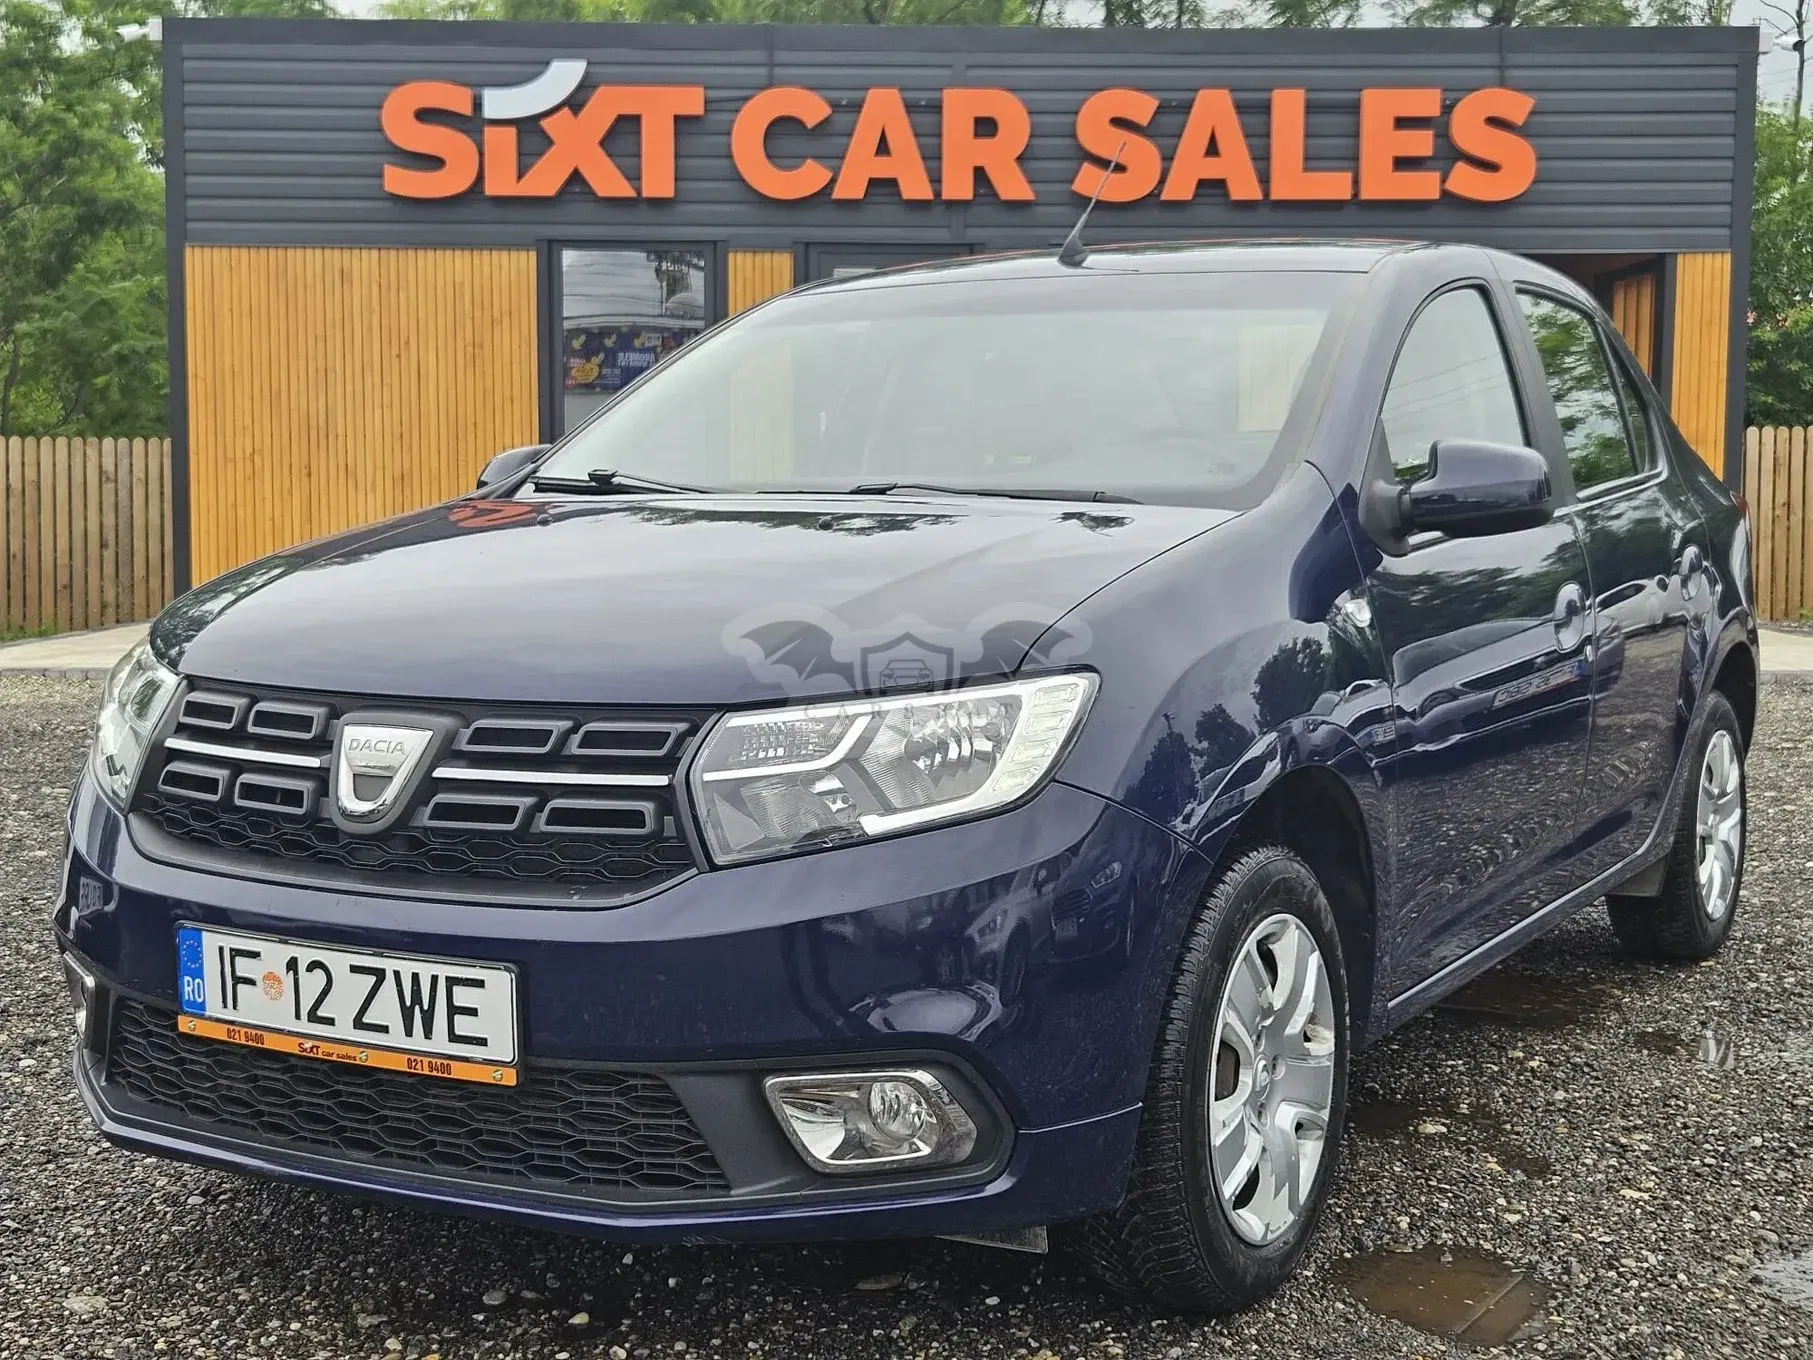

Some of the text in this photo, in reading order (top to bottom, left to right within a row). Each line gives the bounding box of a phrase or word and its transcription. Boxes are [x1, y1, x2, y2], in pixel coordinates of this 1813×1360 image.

[730, 87, 1037, 201] CAR
[1071, 86, 1538, 202] SALES
[349, 738, 406, 755] DACIA
[184, 975, 206, 1003] RO
[218, 945, 489, 1048] IF 12 ZWE
[226, 1027, 242, 1042] 021
[244, 1032, 265, 1046] 9400
[321, 1050, 335, 1058] car
[336, 1053, 358, 1062] sales
[407, 1057, 425, 1072] 021
[428, 1062, 452, 1076] 9400
